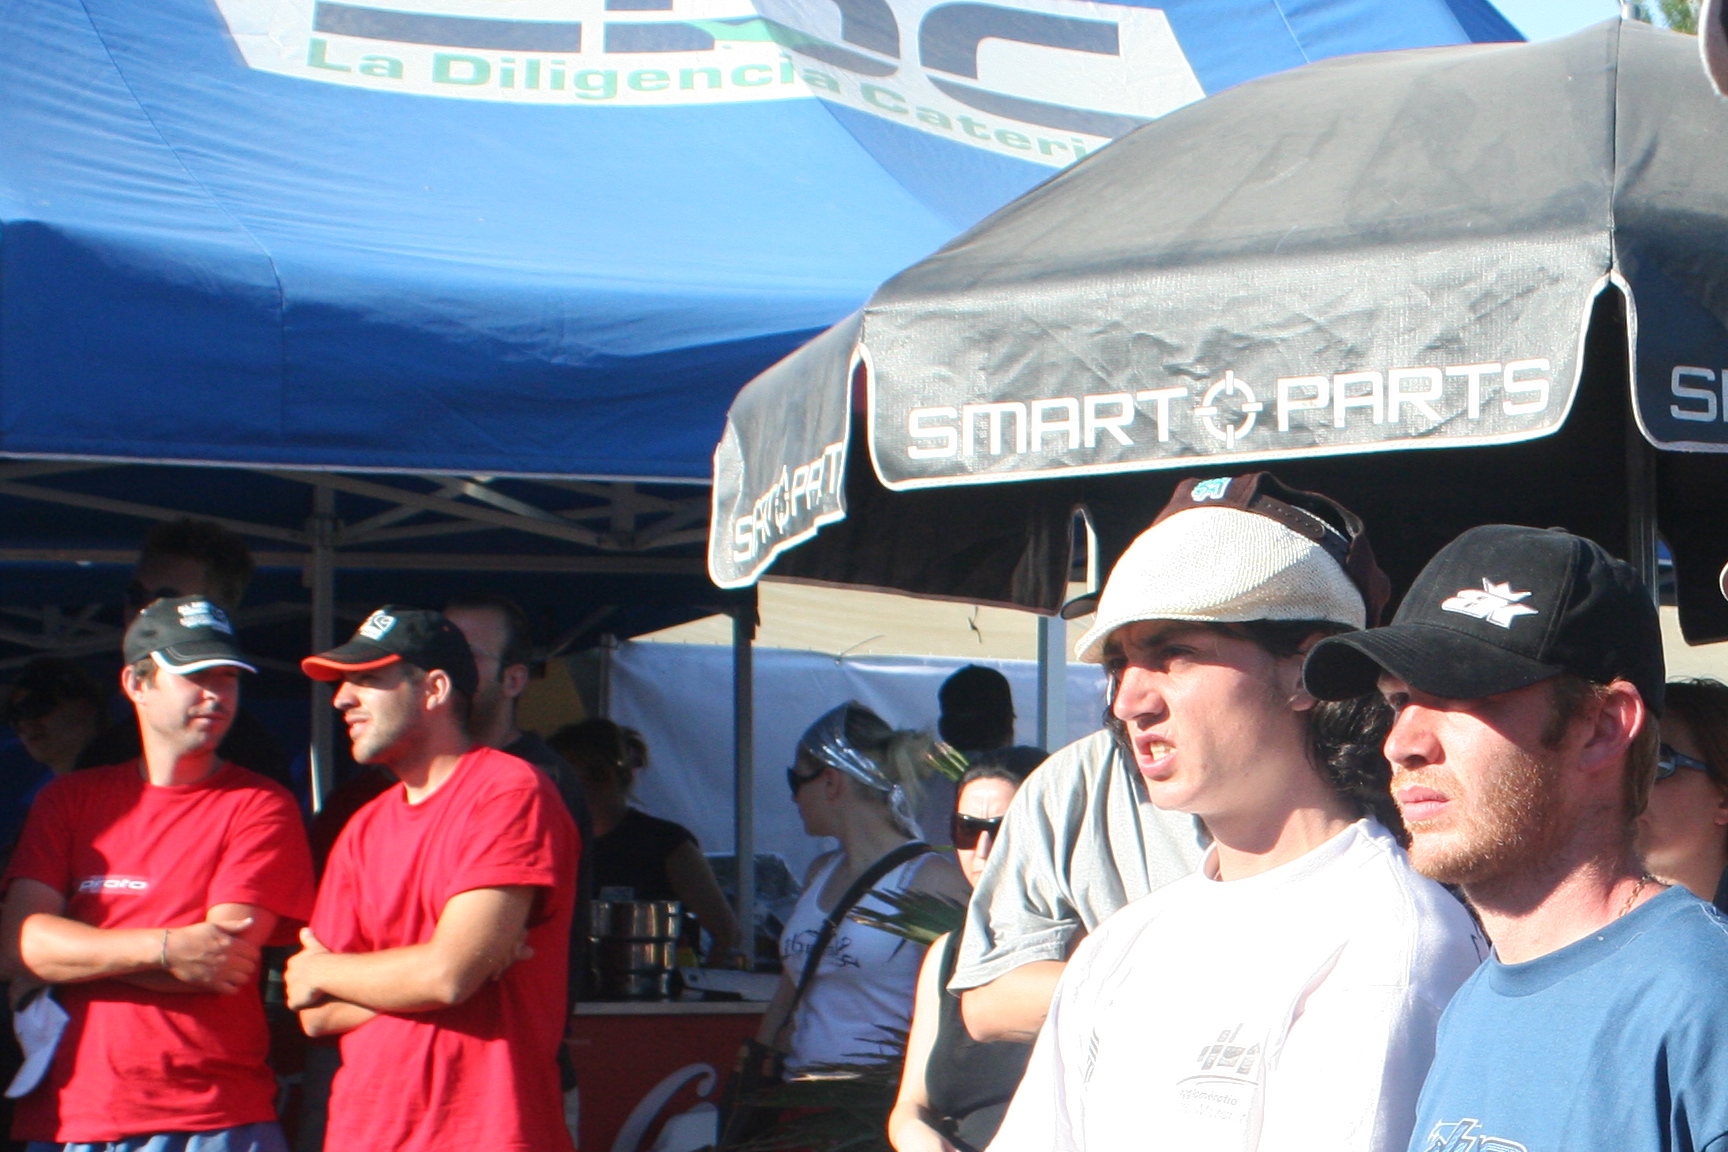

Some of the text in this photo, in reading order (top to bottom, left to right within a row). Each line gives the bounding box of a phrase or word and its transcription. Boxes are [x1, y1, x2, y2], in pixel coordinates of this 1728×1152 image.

[307, 38, 404, 80] La
[431, 43, 841, 100] Diligencia
[859, 79, 1088, 158] Cateri
[906, 358, 1551, 459] SMART PARTS
[79, 878, 148, 892] proto
